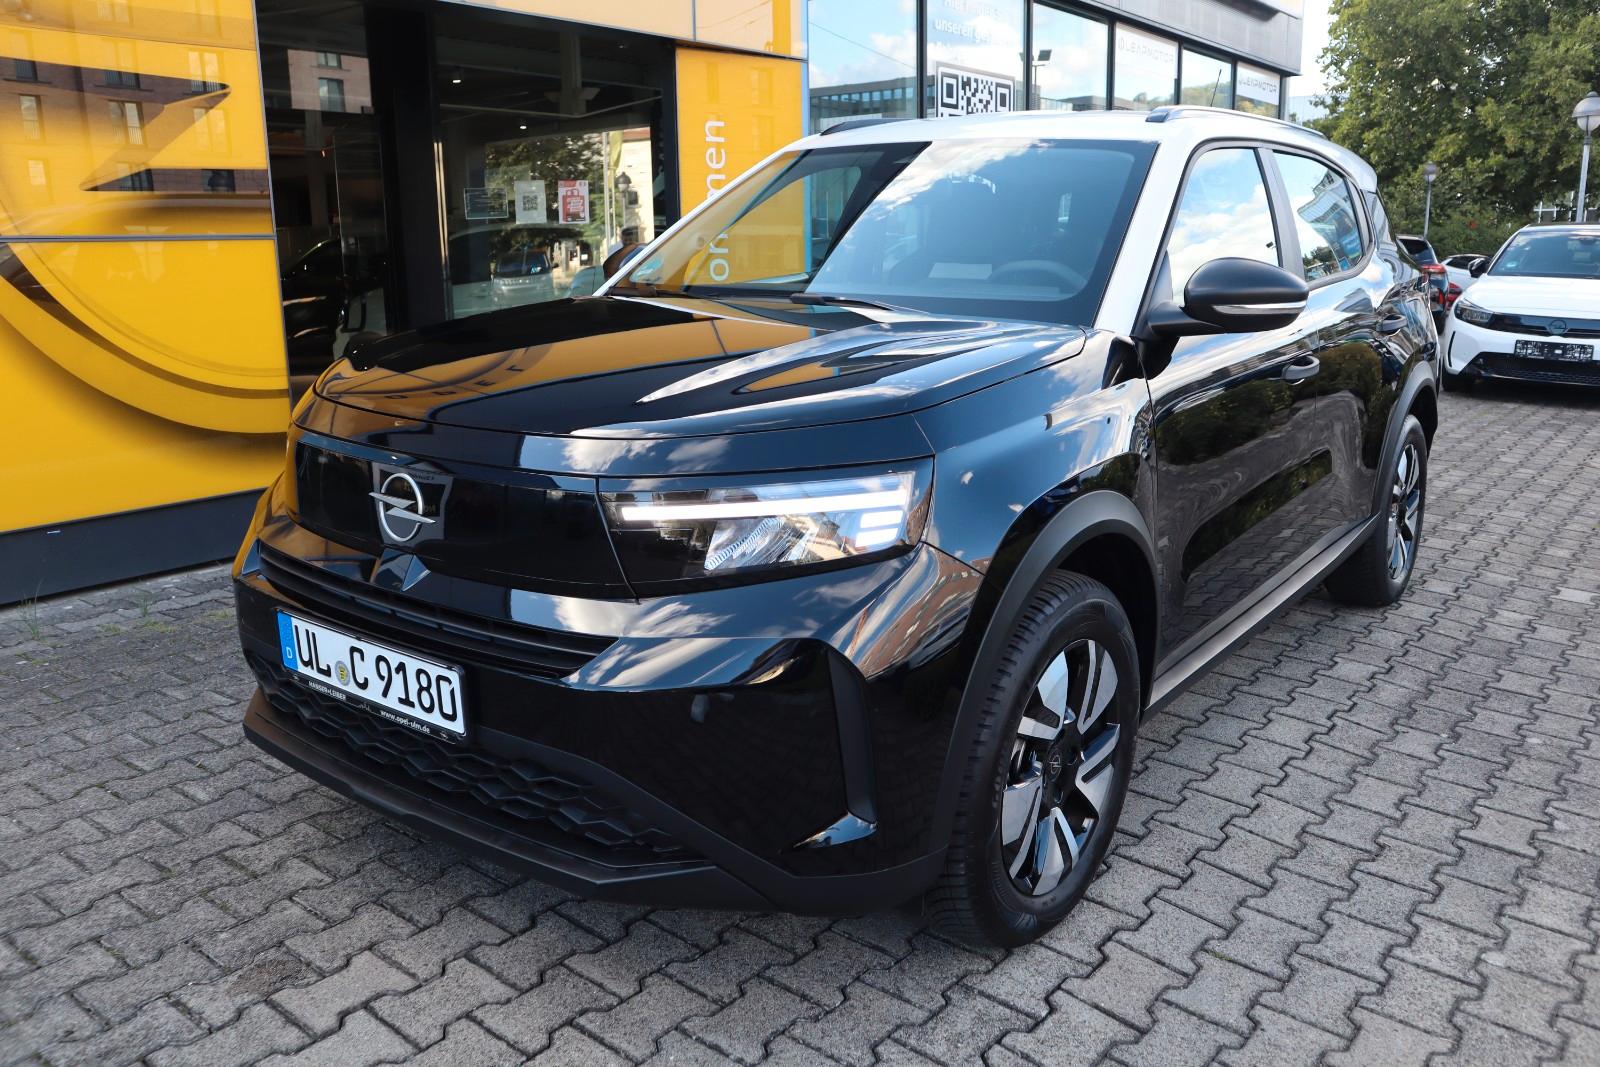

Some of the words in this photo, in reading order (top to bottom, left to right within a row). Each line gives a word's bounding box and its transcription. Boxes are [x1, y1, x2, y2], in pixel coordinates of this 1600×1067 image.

[294, 624, 332, 678] UL
[349, 645, 369, 691] C
[375, 654, 458, 722] 9180
[380, 709, 431, 734] www.opel-ulm.de
